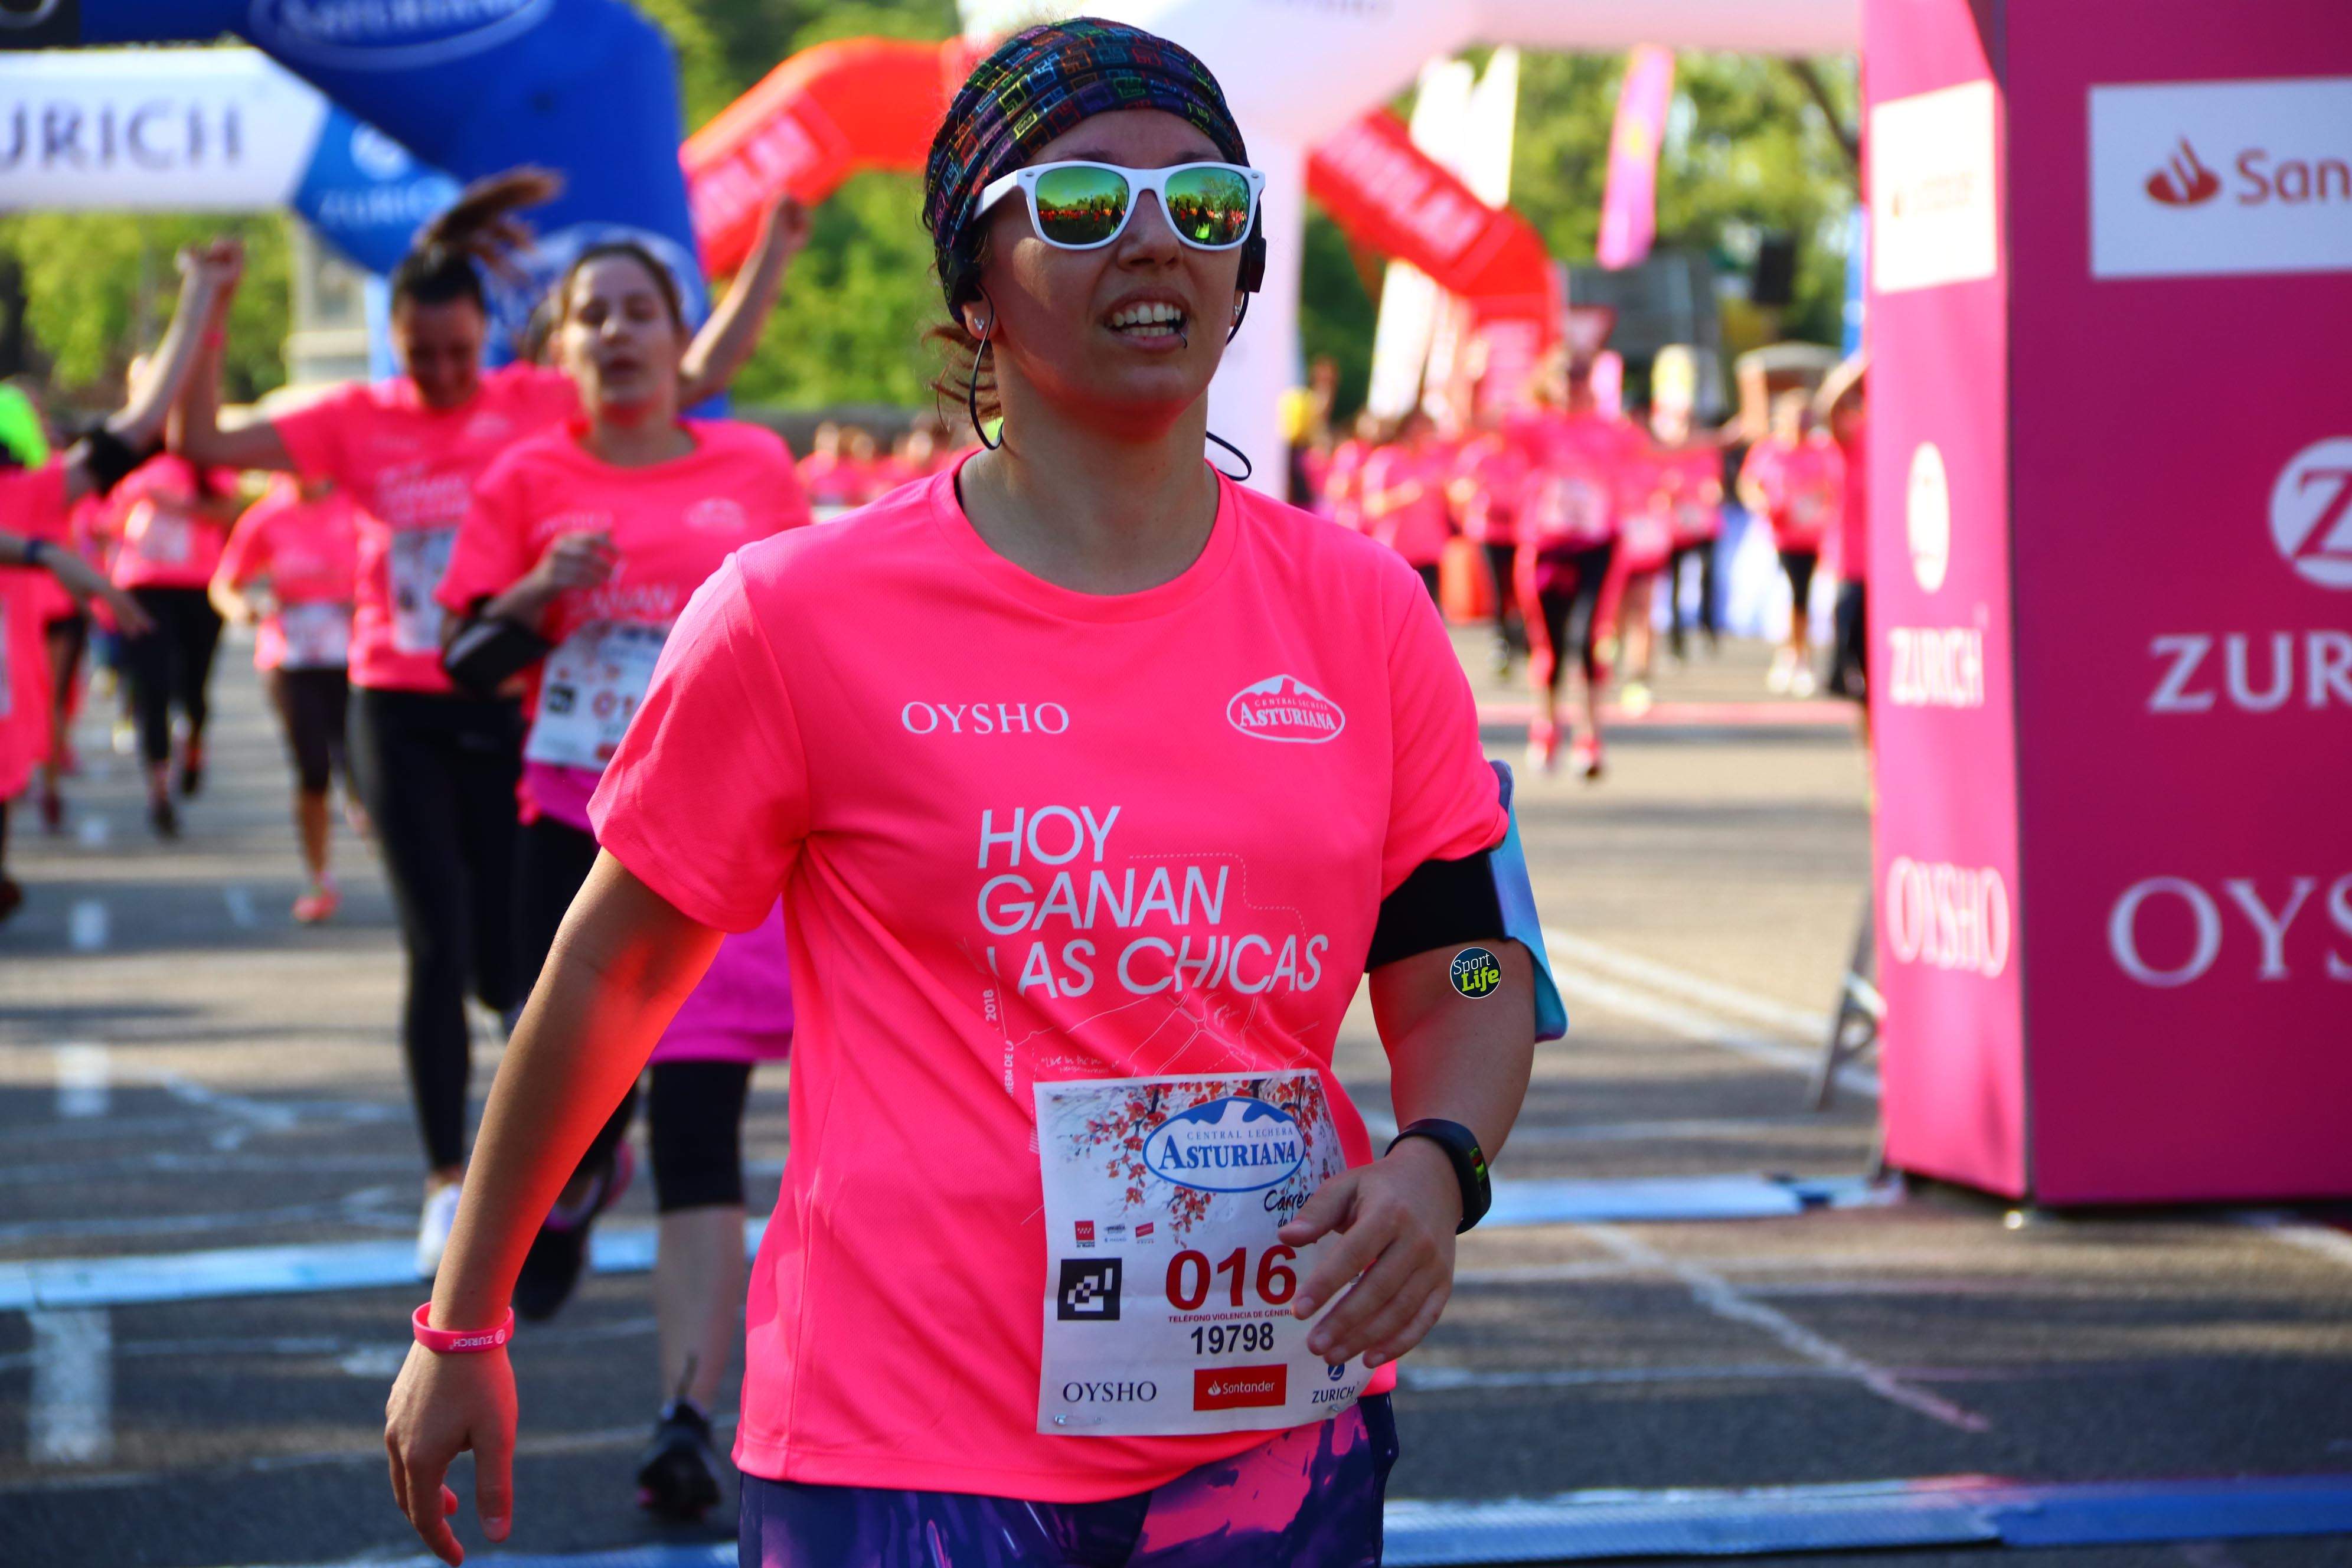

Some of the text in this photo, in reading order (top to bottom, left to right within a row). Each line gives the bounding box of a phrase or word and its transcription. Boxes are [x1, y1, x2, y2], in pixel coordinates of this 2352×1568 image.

[901, 701, 1070, 734] OYSHO
[1240, 702, 1337, 731] ASTURIANA
[1255, 697, 1297, 707] CENTRAL
[977, 805, 1121, 870] HOY
[977, 865, 1230, 936] GANAN
[1888, 855, 2009, 978] OYSHO
[1117, 933, 1329, 995] CHICAS
[982, 989, 997, 1022] 2018
[1187, 1126, 1294, 1141] CENTRAL LECHERA
[1158, 1134, 1298, 1170] ASTURIANA
[1264, 1189, 1314, 1212] Carrer
[1165, 1244, 1297, 1311] 016
[1168, 1313, 1211, 1324] TELÉFONO
[1211, 1311, 1253, 1321] VIOLENCIA
[1253, 1309, 1263, 1319] DE
[453, 1335, 494, 1347] ZURICH
[1190, 1321, 1275, 1355] 19798
[1063, 1380, 1157, 1403] OYSHO
[1223, 1380, 1275, 1395] Santander
[1311, 1385, 1355, 1404] ZURICH
